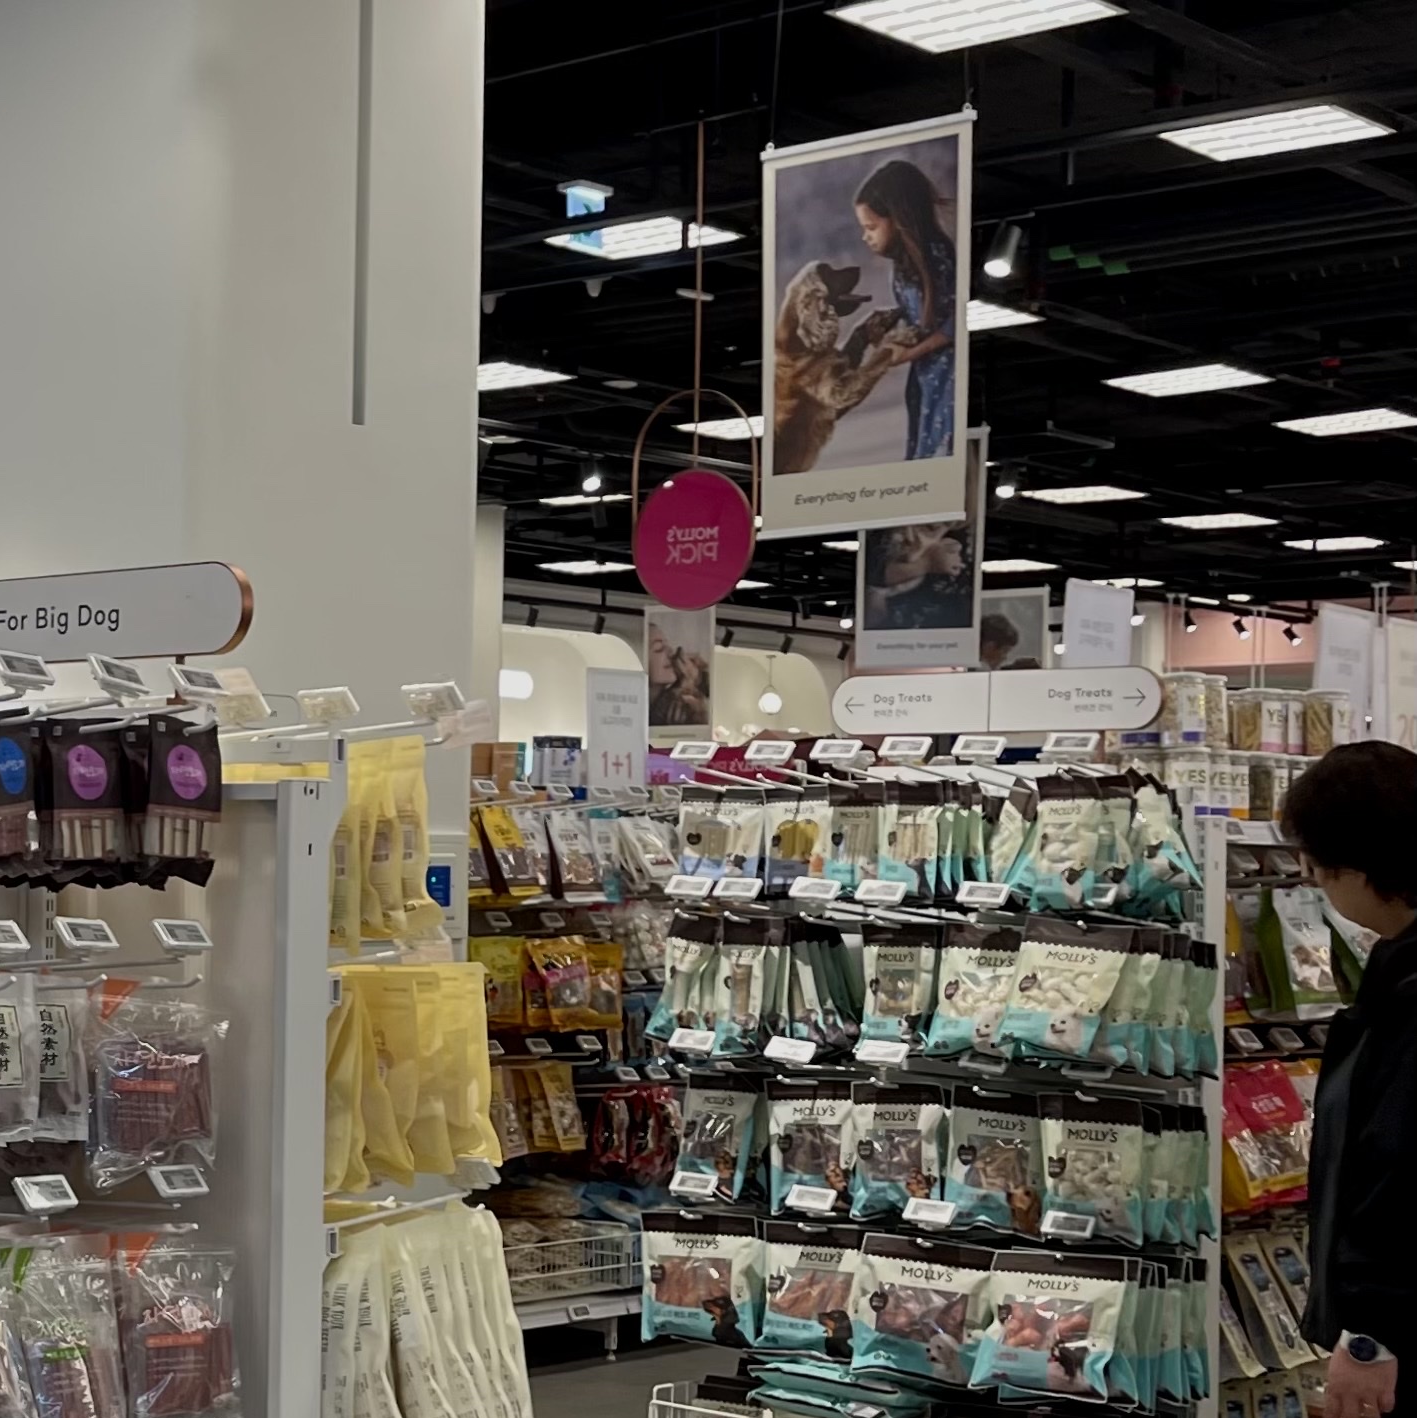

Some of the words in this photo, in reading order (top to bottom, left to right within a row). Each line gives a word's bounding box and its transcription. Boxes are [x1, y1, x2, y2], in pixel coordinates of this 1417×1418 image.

[794, 491, 856, 506] Everything
[859, 486, 876, 498] for
[879, 485, 906, 499] your
[907, 481, 929, 496] pet
[36, 606, 69, 635] Big
[78, 604, 120, 632] Dog
[874, 694, 895, 706] Dog
[898, 693, 932, 703] Treats
[1048, 688, 1071, 700] Dog
[1075, 687, 1113, 698] Treats
[601, 751, 632, 780] 1+1
[1174, 769, 1207, 787] YES
[877, 951, 914, 963] MOLLY'S
[968, 954, 1015, 968] MOLLY'S
[1046, 951, 1098, 965] MOLLY'S
[39, 1008, 58, 1067] 自然素材
[793, 1105, 836, 1117] MOLLY'S
[873, 1109, 917, 1122] MOLLY'S
[978, 1116, 1027, 1132] MOLLY'S
[1067, 1127, 1118, 1142] MOLLY'S
[674, 1237, 720, 1250] MOLLY'S
[799, 1250, 843, 1264] MOLLY'S
[901, 1265, 954, 1283] MOLLY'S
[1028, 1278, 1080, 1292] MOLLY'S
